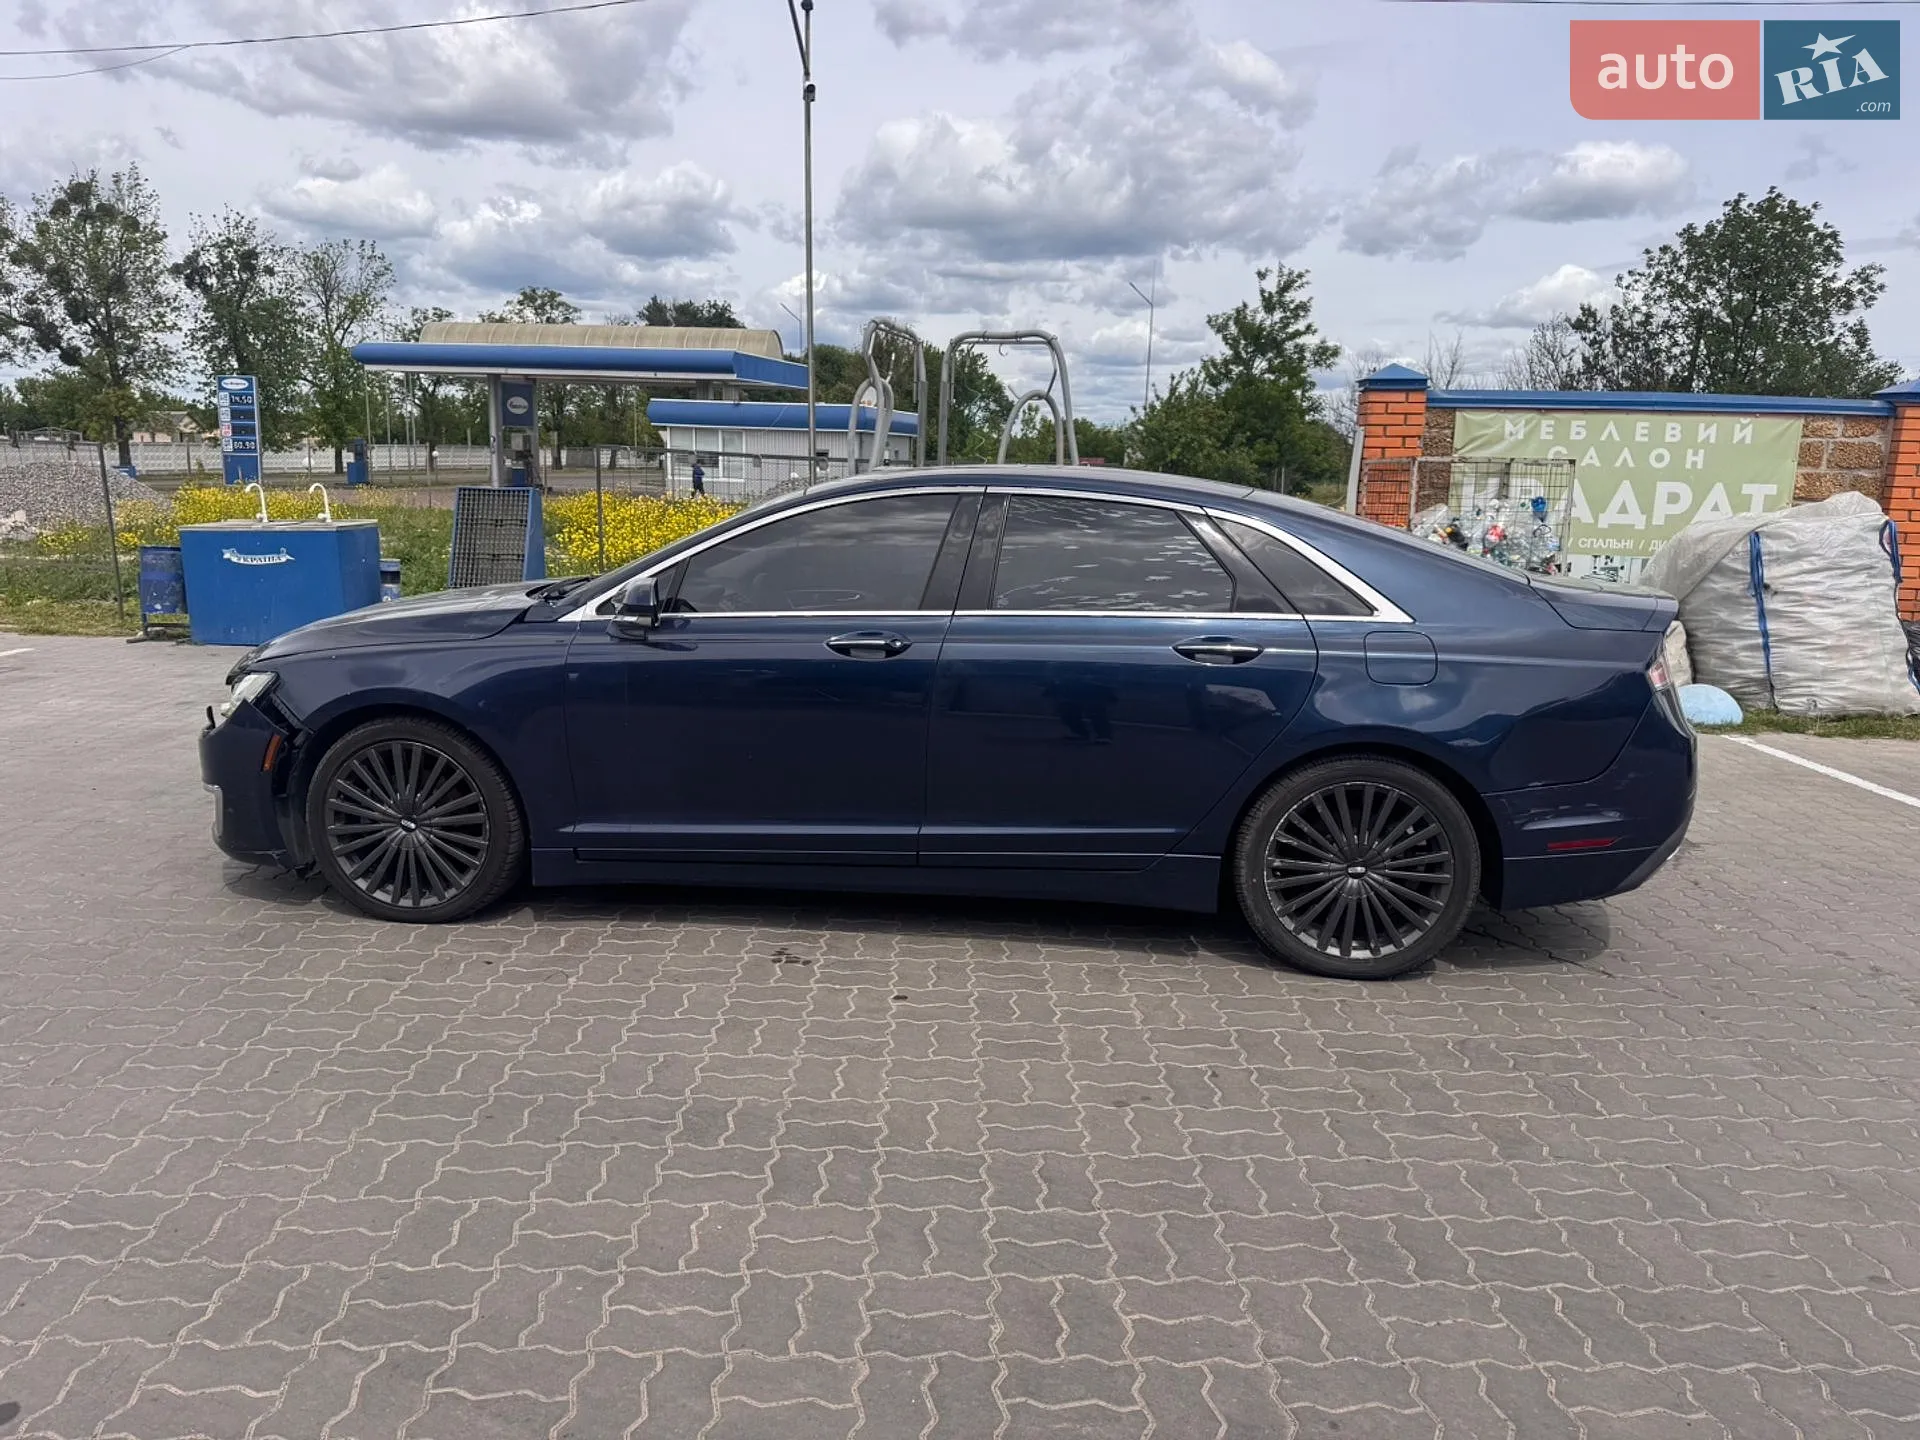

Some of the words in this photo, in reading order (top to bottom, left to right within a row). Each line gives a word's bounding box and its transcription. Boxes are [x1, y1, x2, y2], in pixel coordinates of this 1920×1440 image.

[1504, 418, 1754, 445] МЕБЛЕВИЙ
[1548, 446, 1705, 470] САЛОН
[1578, 538, 1634, 549] СПАЛЬНІ
